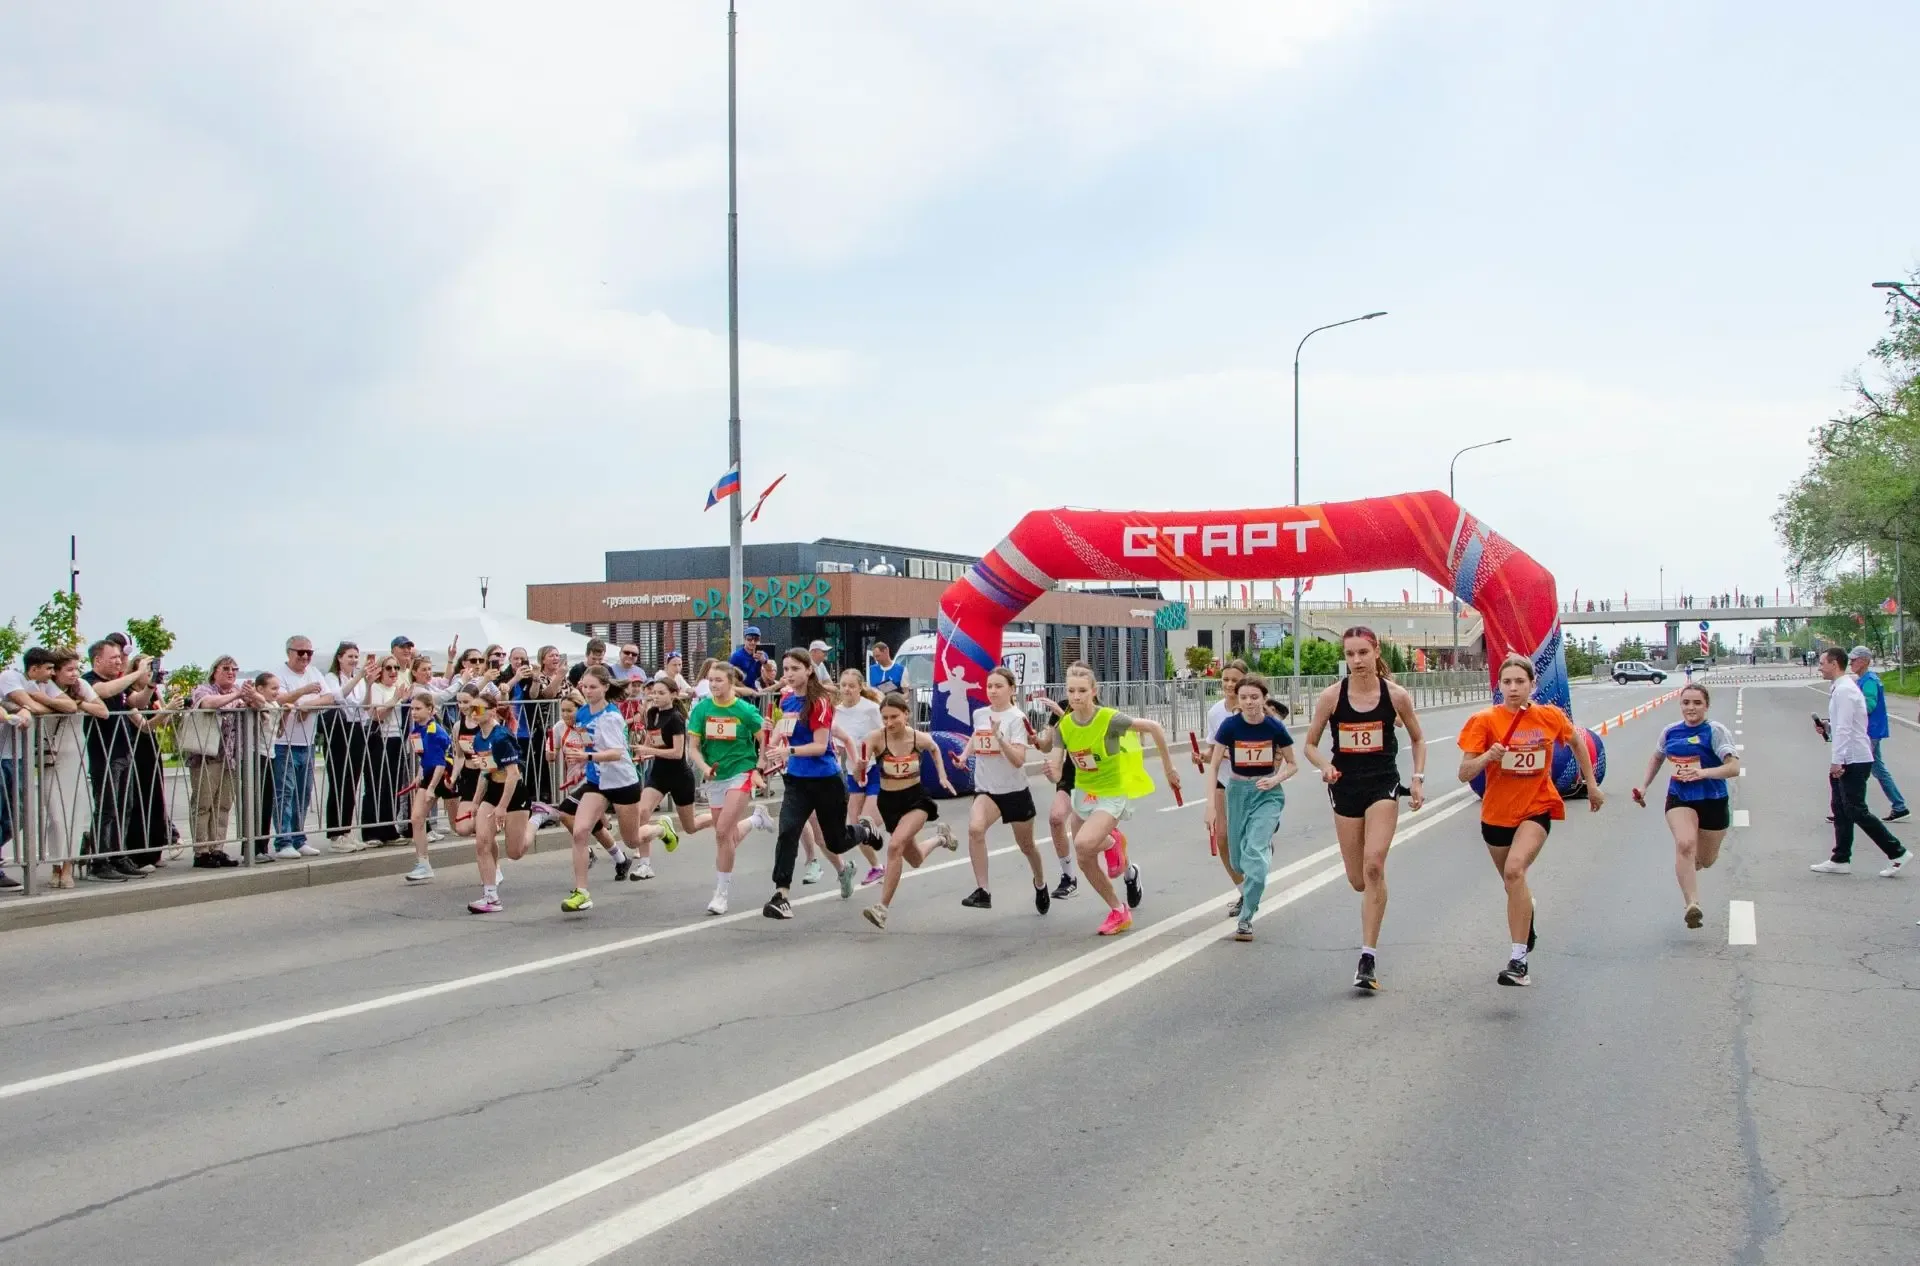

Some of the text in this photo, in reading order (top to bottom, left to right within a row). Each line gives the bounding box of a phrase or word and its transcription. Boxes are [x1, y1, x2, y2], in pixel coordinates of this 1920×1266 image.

[1123, 519, 1320, 556] СТАРТ
[606, 594, 686, 608] грузинский ресторан
[716, 723, 725, 735] 8
[979, 736, 992, 749] 13
[1351, 731, 1372, 746] 18
[1245, 749, 1263, 761] 17
[1514, 752, 1535, 768] 20
[481, 757, 488, 768] 5
[892, 762, 910, 774] 12
[1675, 763, 1689, 776] 2
